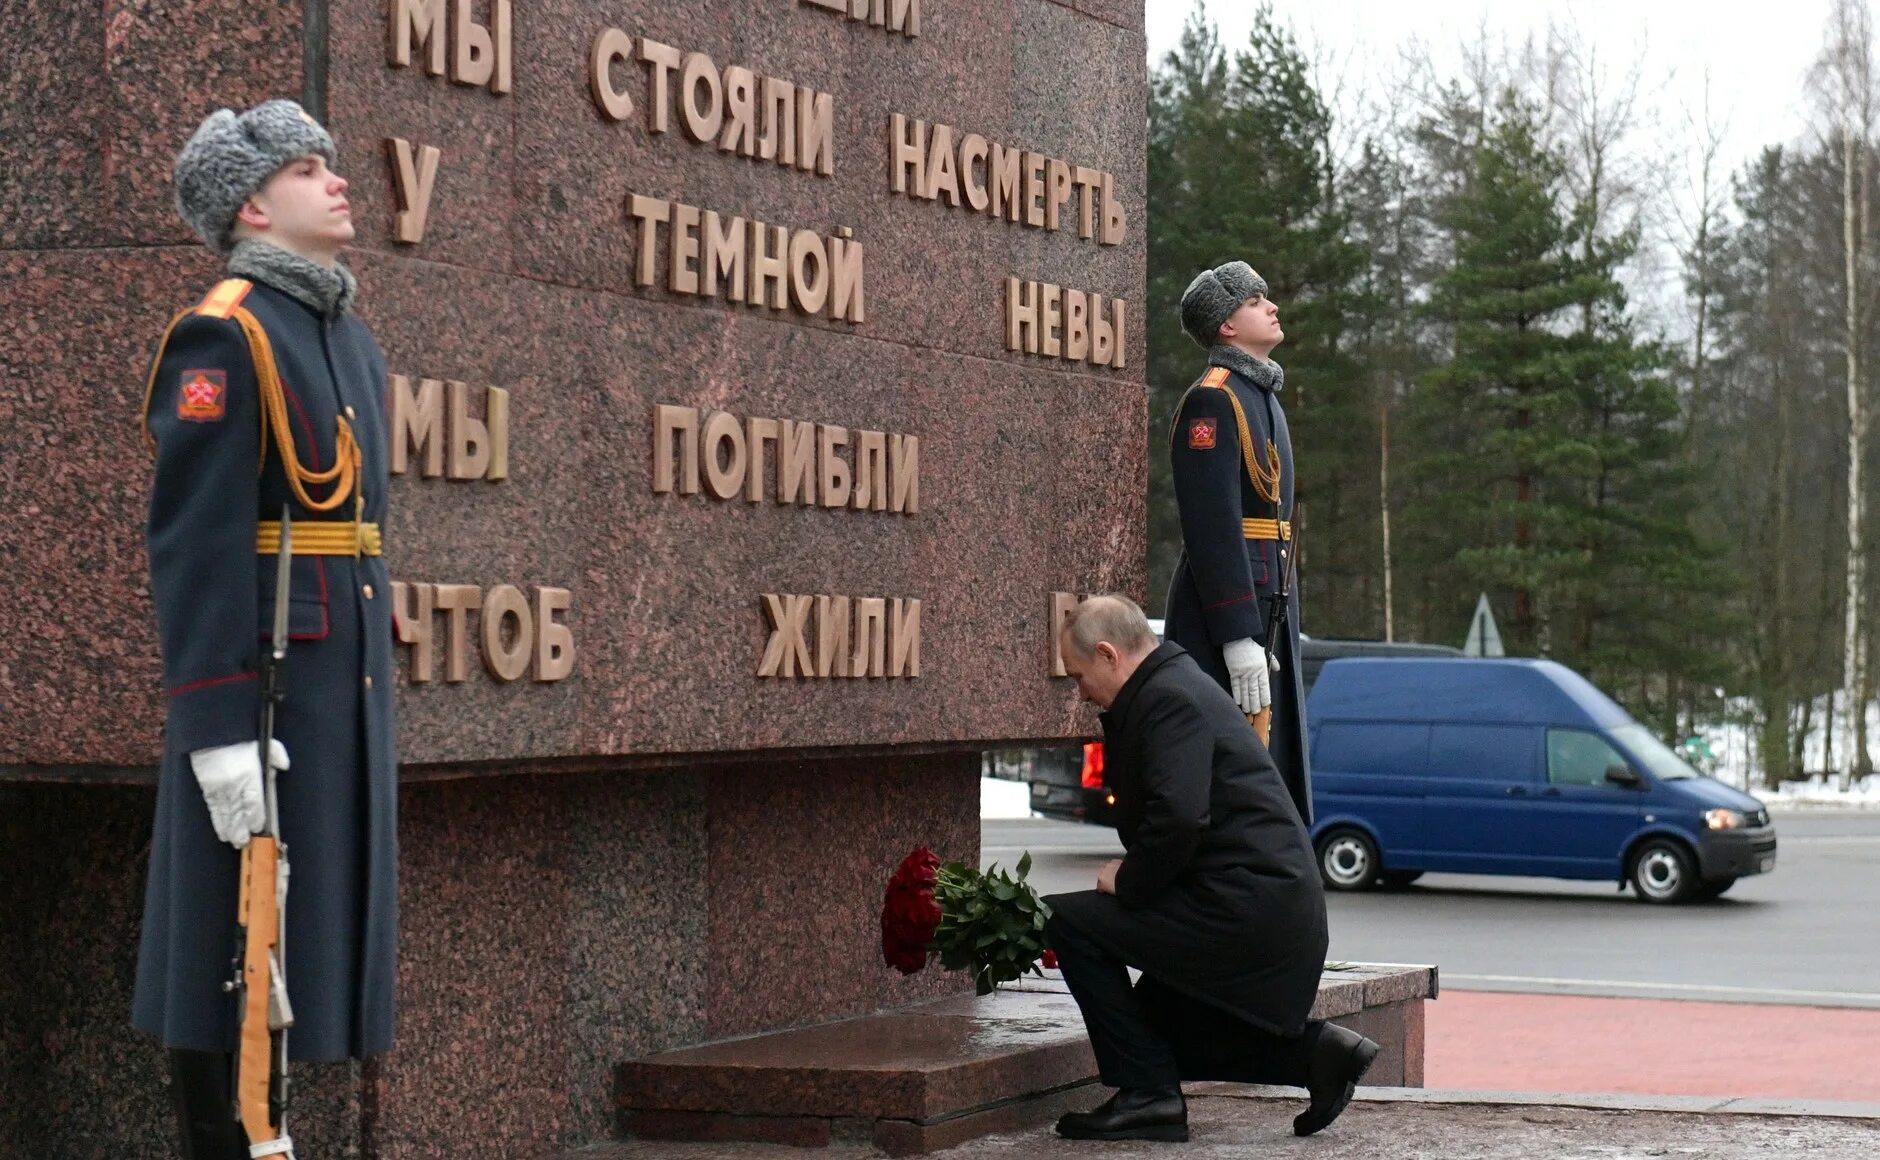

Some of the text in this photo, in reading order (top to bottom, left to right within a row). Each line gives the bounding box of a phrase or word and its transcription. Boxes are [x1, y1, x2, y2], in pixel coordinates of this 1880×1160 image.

[389, 0, 1127, 246] МЫ СТОЯЛИ НАСМЕРТЬ
[386, 137, 1125, 368] У ТЕМНОЙ НЕВЫ
[390, 374, 919, 513] МЫ ПОГИБЛИ
[390, 581, 921, 682] ЧТОБ ЖИЛИ
